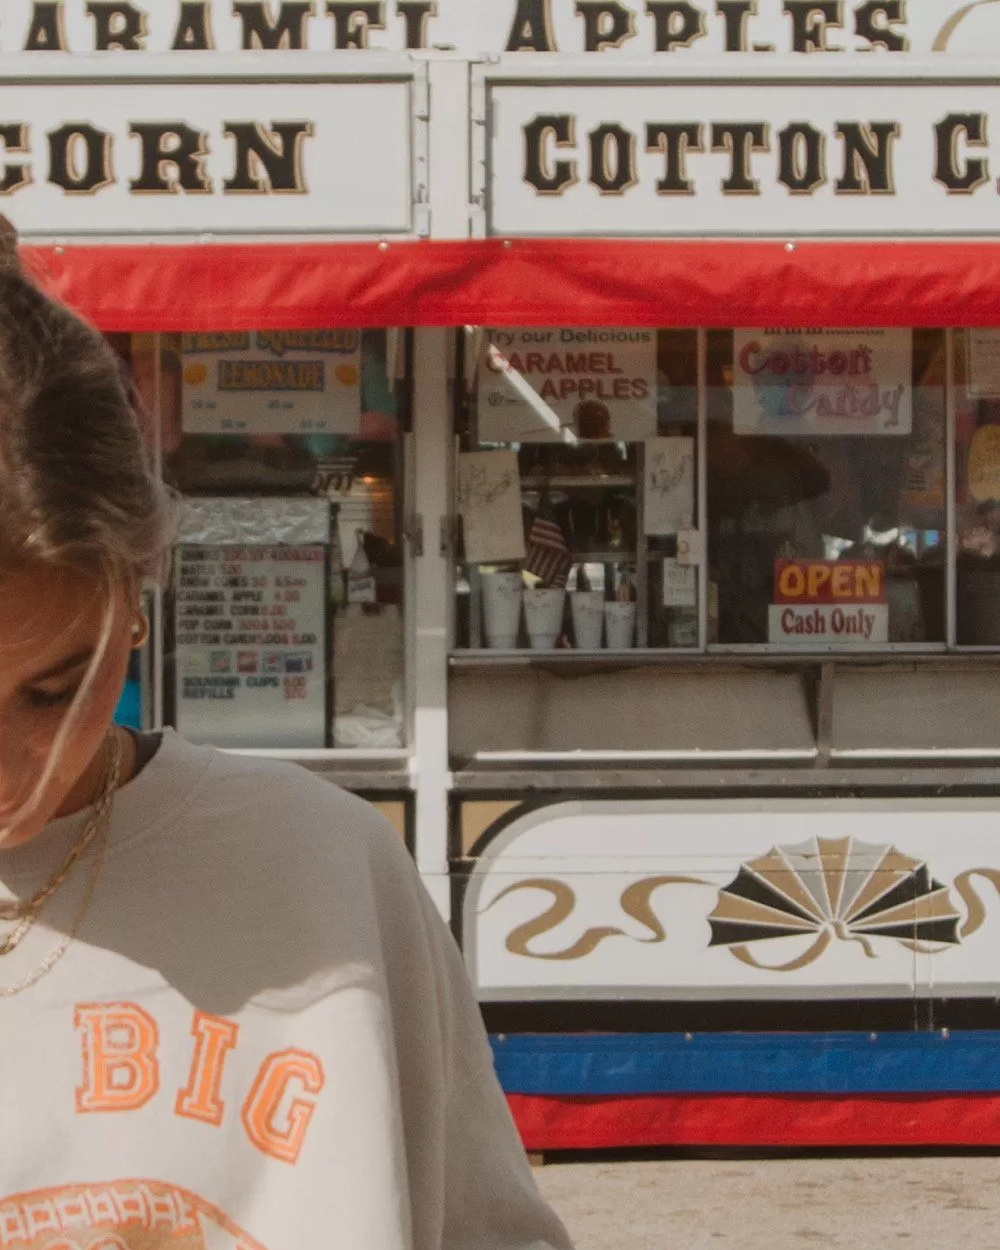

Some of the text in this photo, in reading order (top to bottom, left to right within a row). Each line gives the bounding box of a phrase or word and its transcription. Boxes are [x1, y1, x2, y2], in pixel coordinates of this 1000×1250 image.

[506, 0, 909, 52] APPLES
[521, 112, 1000, 196] COTTON C
[521, 331, 550, 343] our
[560, 328, 651, 343] Delicious
[738, 340, 873, 375] Cotton
[540, 377, 648, 401] APPLES
[779, 563, 880, 597] OPEN
[781, 608, 876, 638] Cash Only
[74, 1001, 325, 1165] BIG
